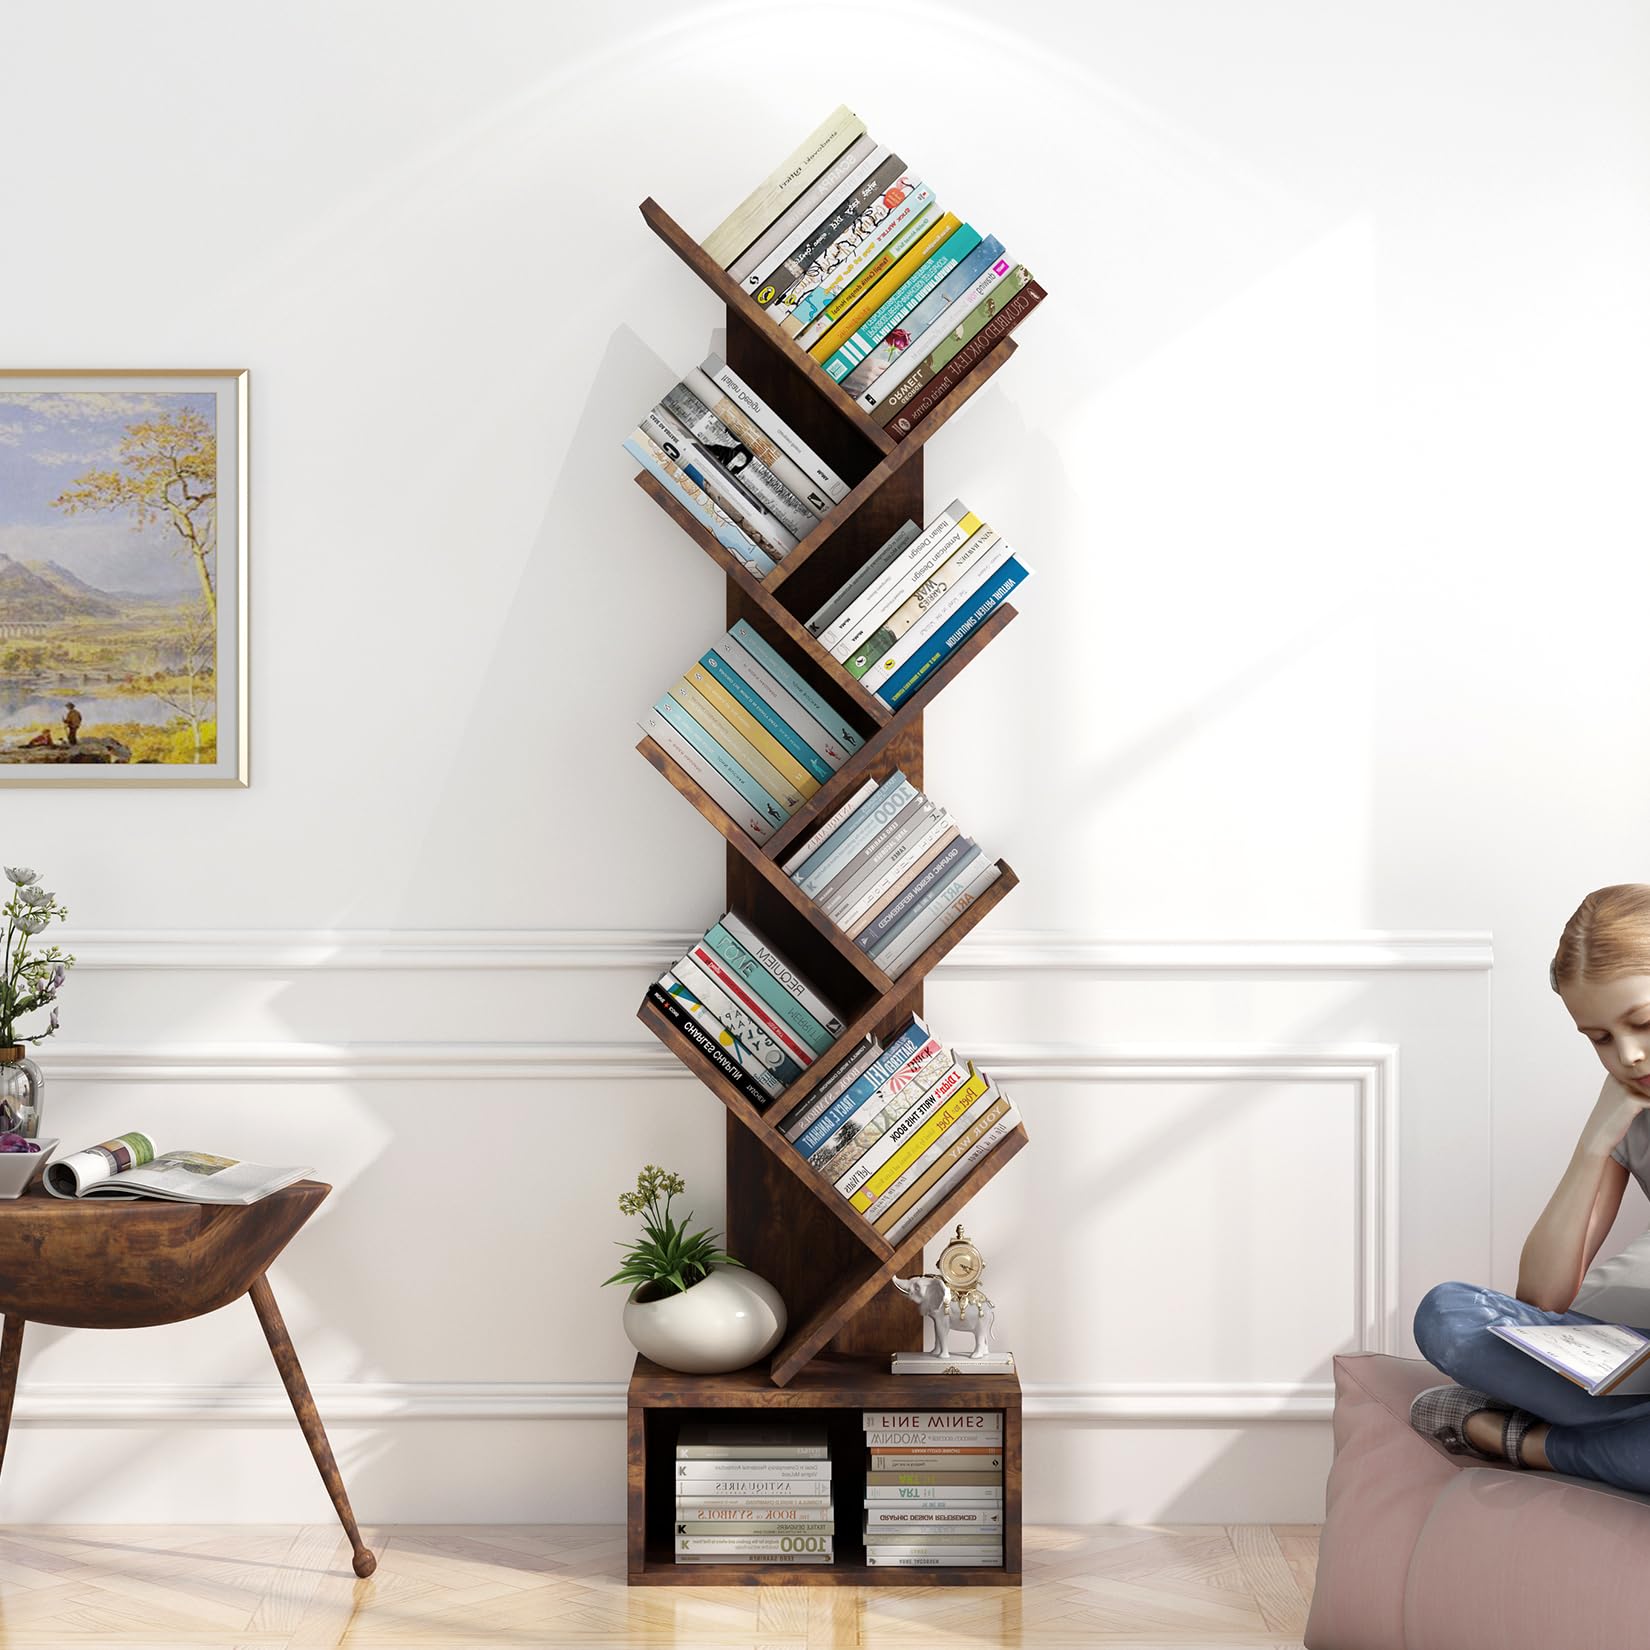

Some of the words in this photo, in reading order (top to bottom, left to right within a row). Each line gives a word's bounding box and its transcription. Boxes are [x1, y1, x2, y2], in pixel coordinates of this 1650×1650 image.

[927, 519, 949, 541] Italian
[976, 528, 993, 545] NINA
[906, 535, 931, 560] Design
[931, 532, 962, 563] American
[954, 542, 980, 567] BAWDEN
[909, 558, 934, 583] Design
[912, 577, 937, 602] WAR
[991, 577, 1016, 601] VIRTUAL
[972, 596, 996, 620] PATIENT
[944, 615, 978, 648] SIMULATION
